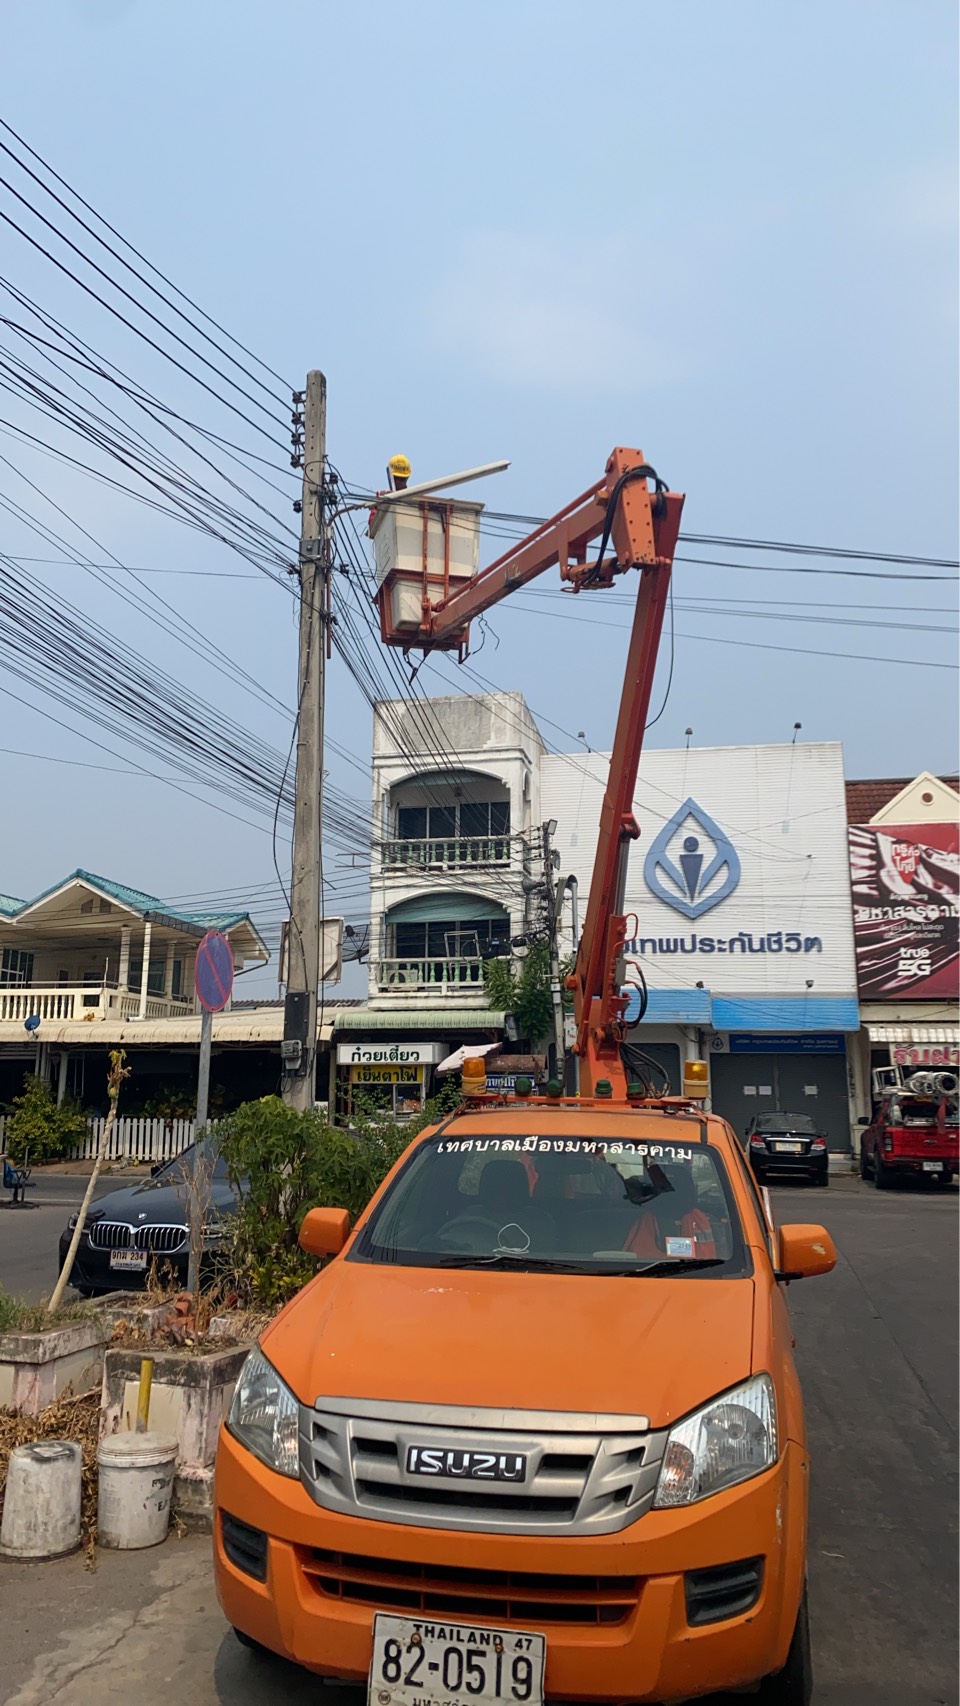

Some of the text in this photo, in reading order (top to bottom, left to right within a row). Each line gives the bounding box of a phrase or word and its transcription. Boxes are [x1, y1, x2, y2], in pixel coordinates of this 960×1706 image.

[899, 947, 930, 958] true
[897, 959, 931, 975] 5G
[357, 1065, 418, 1082] เย็นตาโฟ
[437, 1135, 692, 1160] เทศบาลเมืองมหาสารคาม
[409, 1448, 523, 1479] ISUZU
[413, 1623, 503, 1648] THAILAND
[382, 1638, 533, 1701] 82-0519
